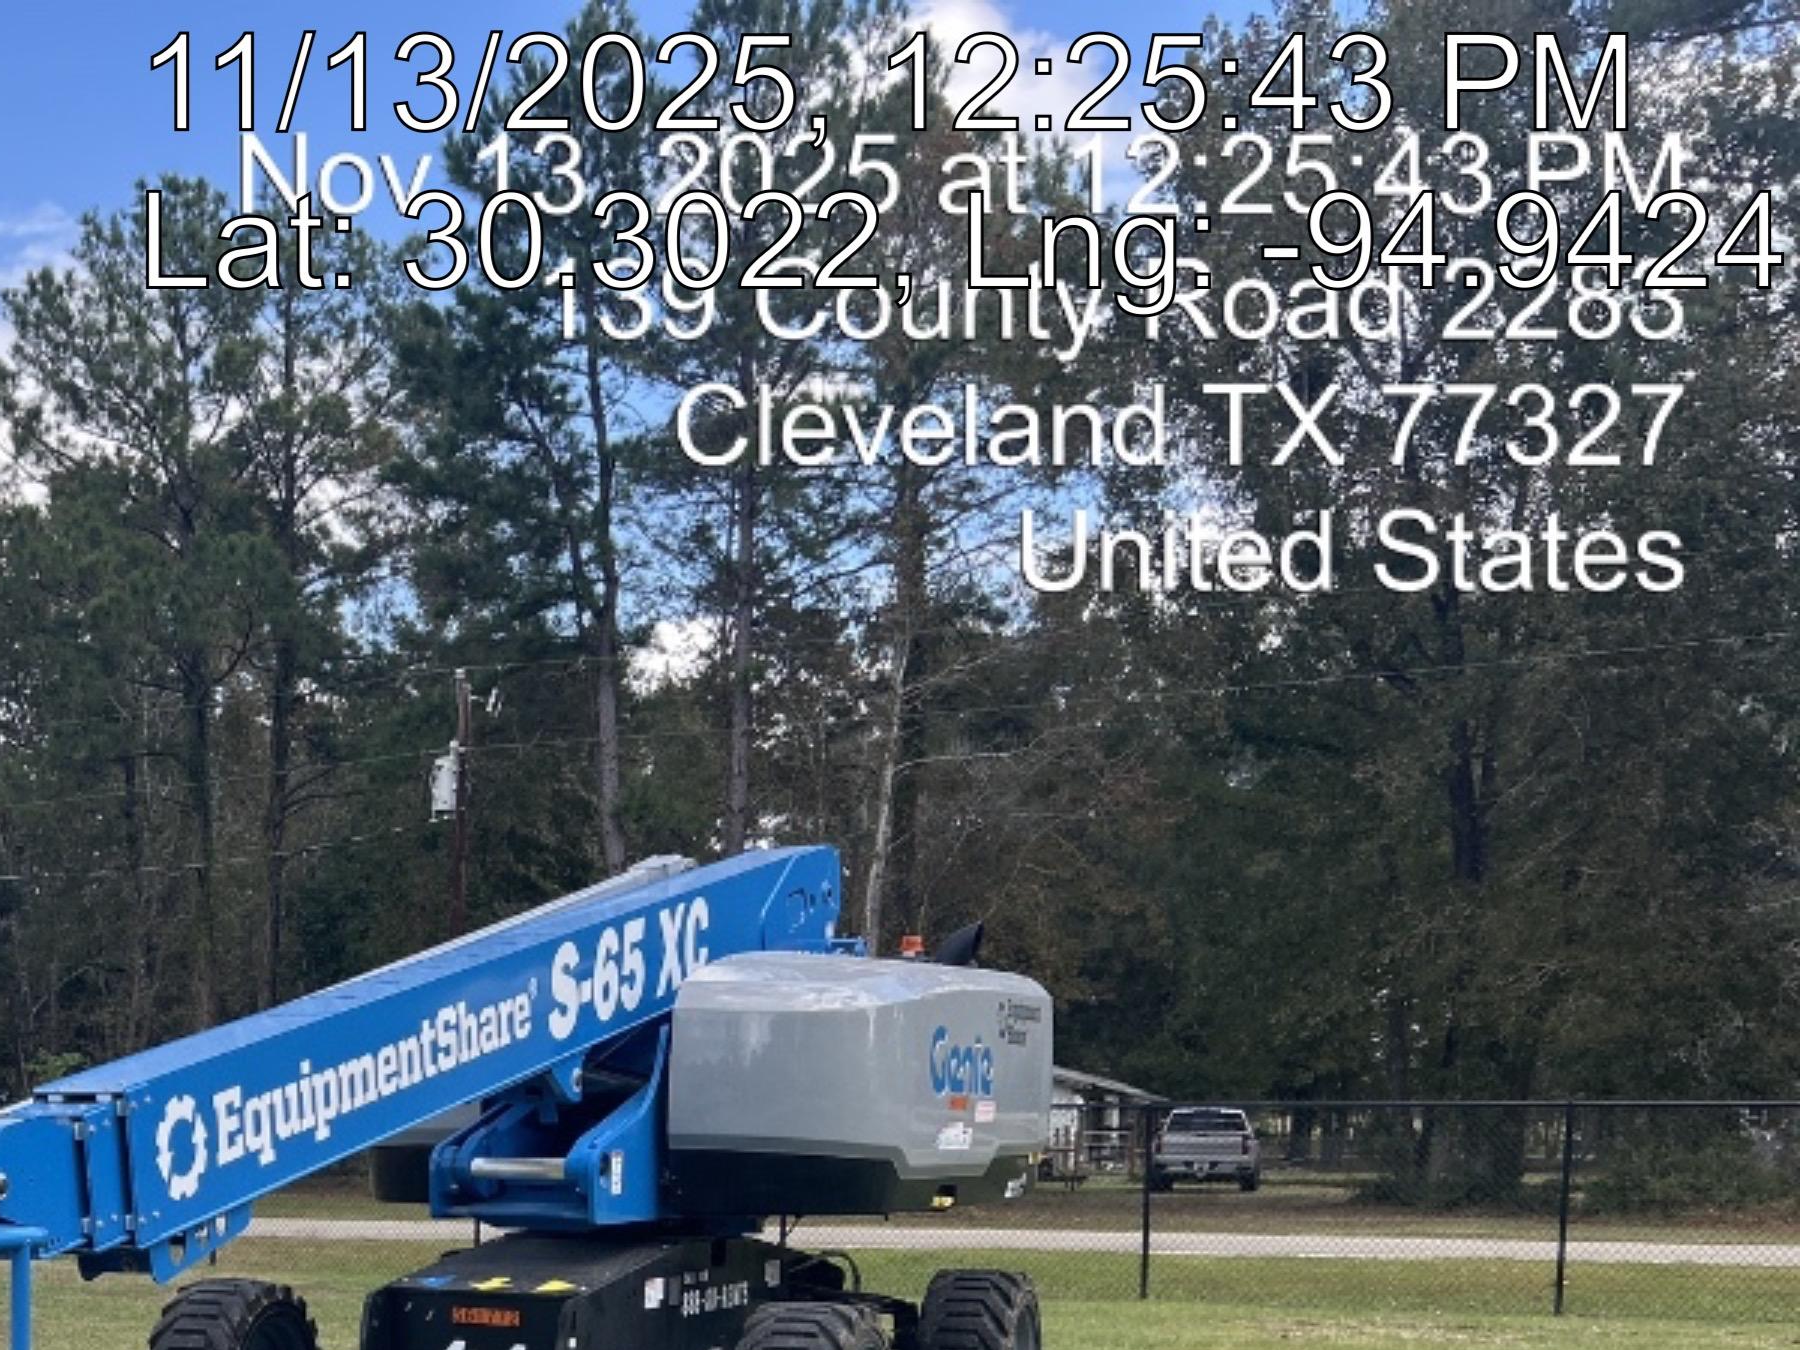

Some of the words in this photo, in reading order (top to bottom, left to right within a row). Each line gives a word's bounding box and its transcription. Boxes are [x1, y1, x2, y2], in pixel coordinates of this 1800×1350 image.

[211, 994, 532, 1167] EquipmentShare
[548, 917, 647, 1042] S-65
[657, 896, 711, 998] XC
[929, 1025, 993, 1096] Genie
